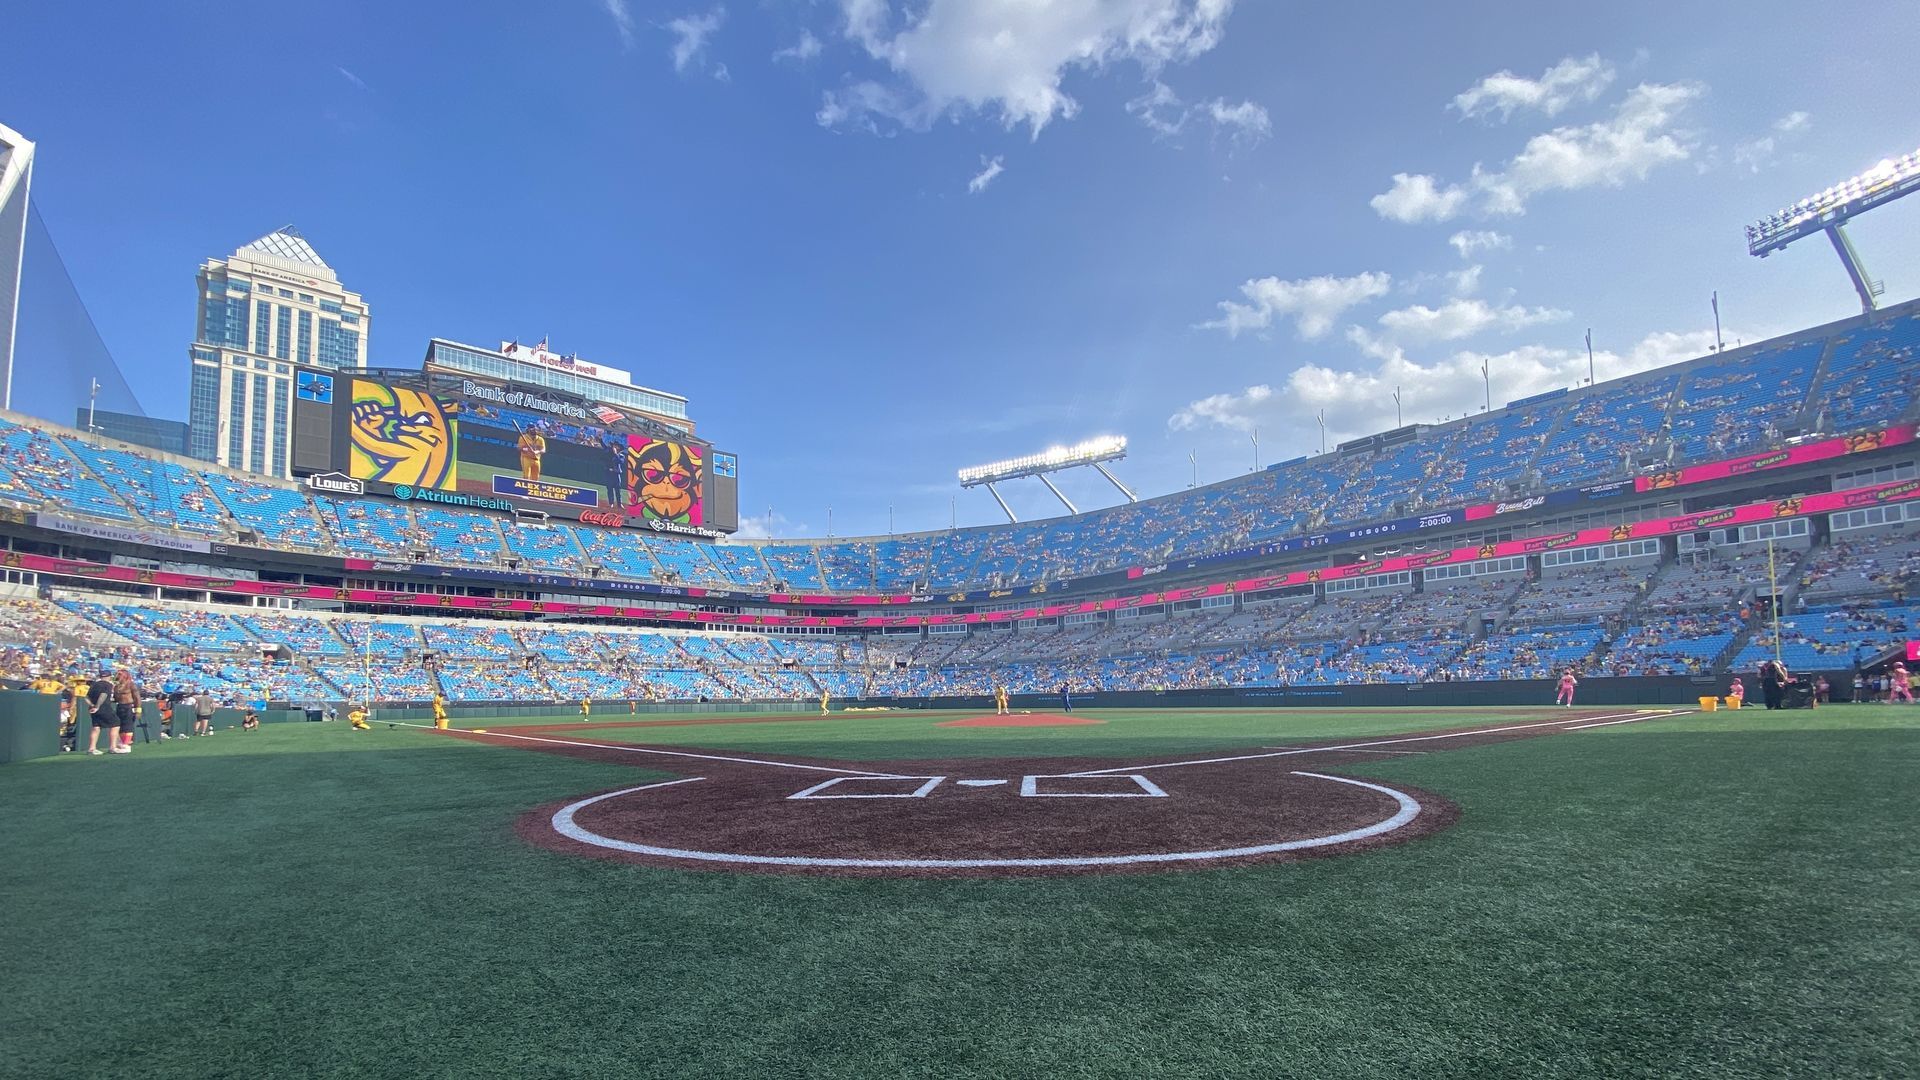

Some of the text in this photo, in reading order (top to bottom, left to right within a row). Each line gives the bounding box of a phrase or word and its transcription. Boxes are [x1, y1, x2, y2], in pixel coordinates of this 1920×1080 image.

[540, 354, 597, 376] Honeywell
[463, 380, 586, 419] Bank of America
[316, 476, 359, 492] LOWE'S
[514, 481, 541, 490] ALEX
[416, 488, 514, 511] Atrium Health
[527, 489, 567, 501] ZEIGLER
[666, 522, 726, 538] Harris Teeter
[1419, 516, 1452, 528] 2:00:00
[55, 521, 193, 550] BANK OF AMERICA STADIUM
